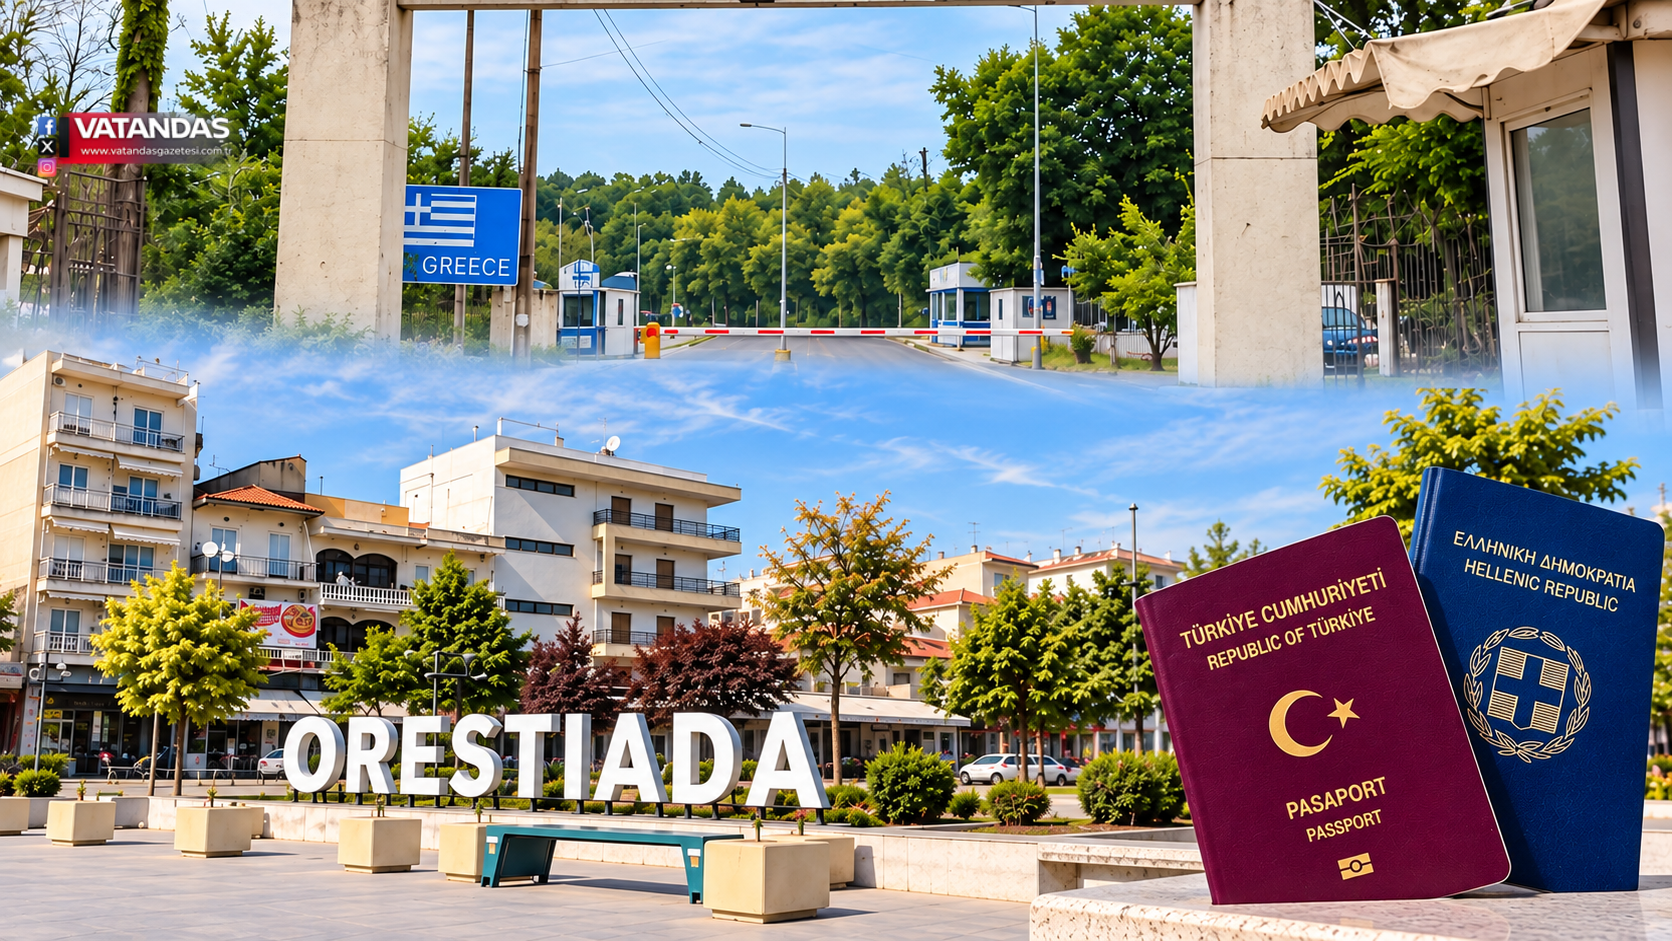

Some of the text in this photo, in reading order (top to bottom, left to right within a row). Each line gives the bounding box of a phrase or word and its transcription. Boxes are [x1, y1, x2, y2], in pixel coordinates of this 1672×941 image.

[422, 255, 510, 277] GREECE
[1453, 530, 1637, 593] ΕΛΛΗΝΙΚΗ ΔΗΜΟΚΡΑΤΙΑ
[1464, 558, 1620, 613] HELLENIC REPUBLIC
[1179, 567, 1388, 649] TÜRKİYE CUMHURİYETİ
[1206, 606, 1377, 671] REPUBLIC OF TÜRKİYE
[283, 712, 829, 808] ORESTIADA
[1285, 776, 1387, 820] PASAPORT
[1305, 808, 1383, 843] PASSPORT
